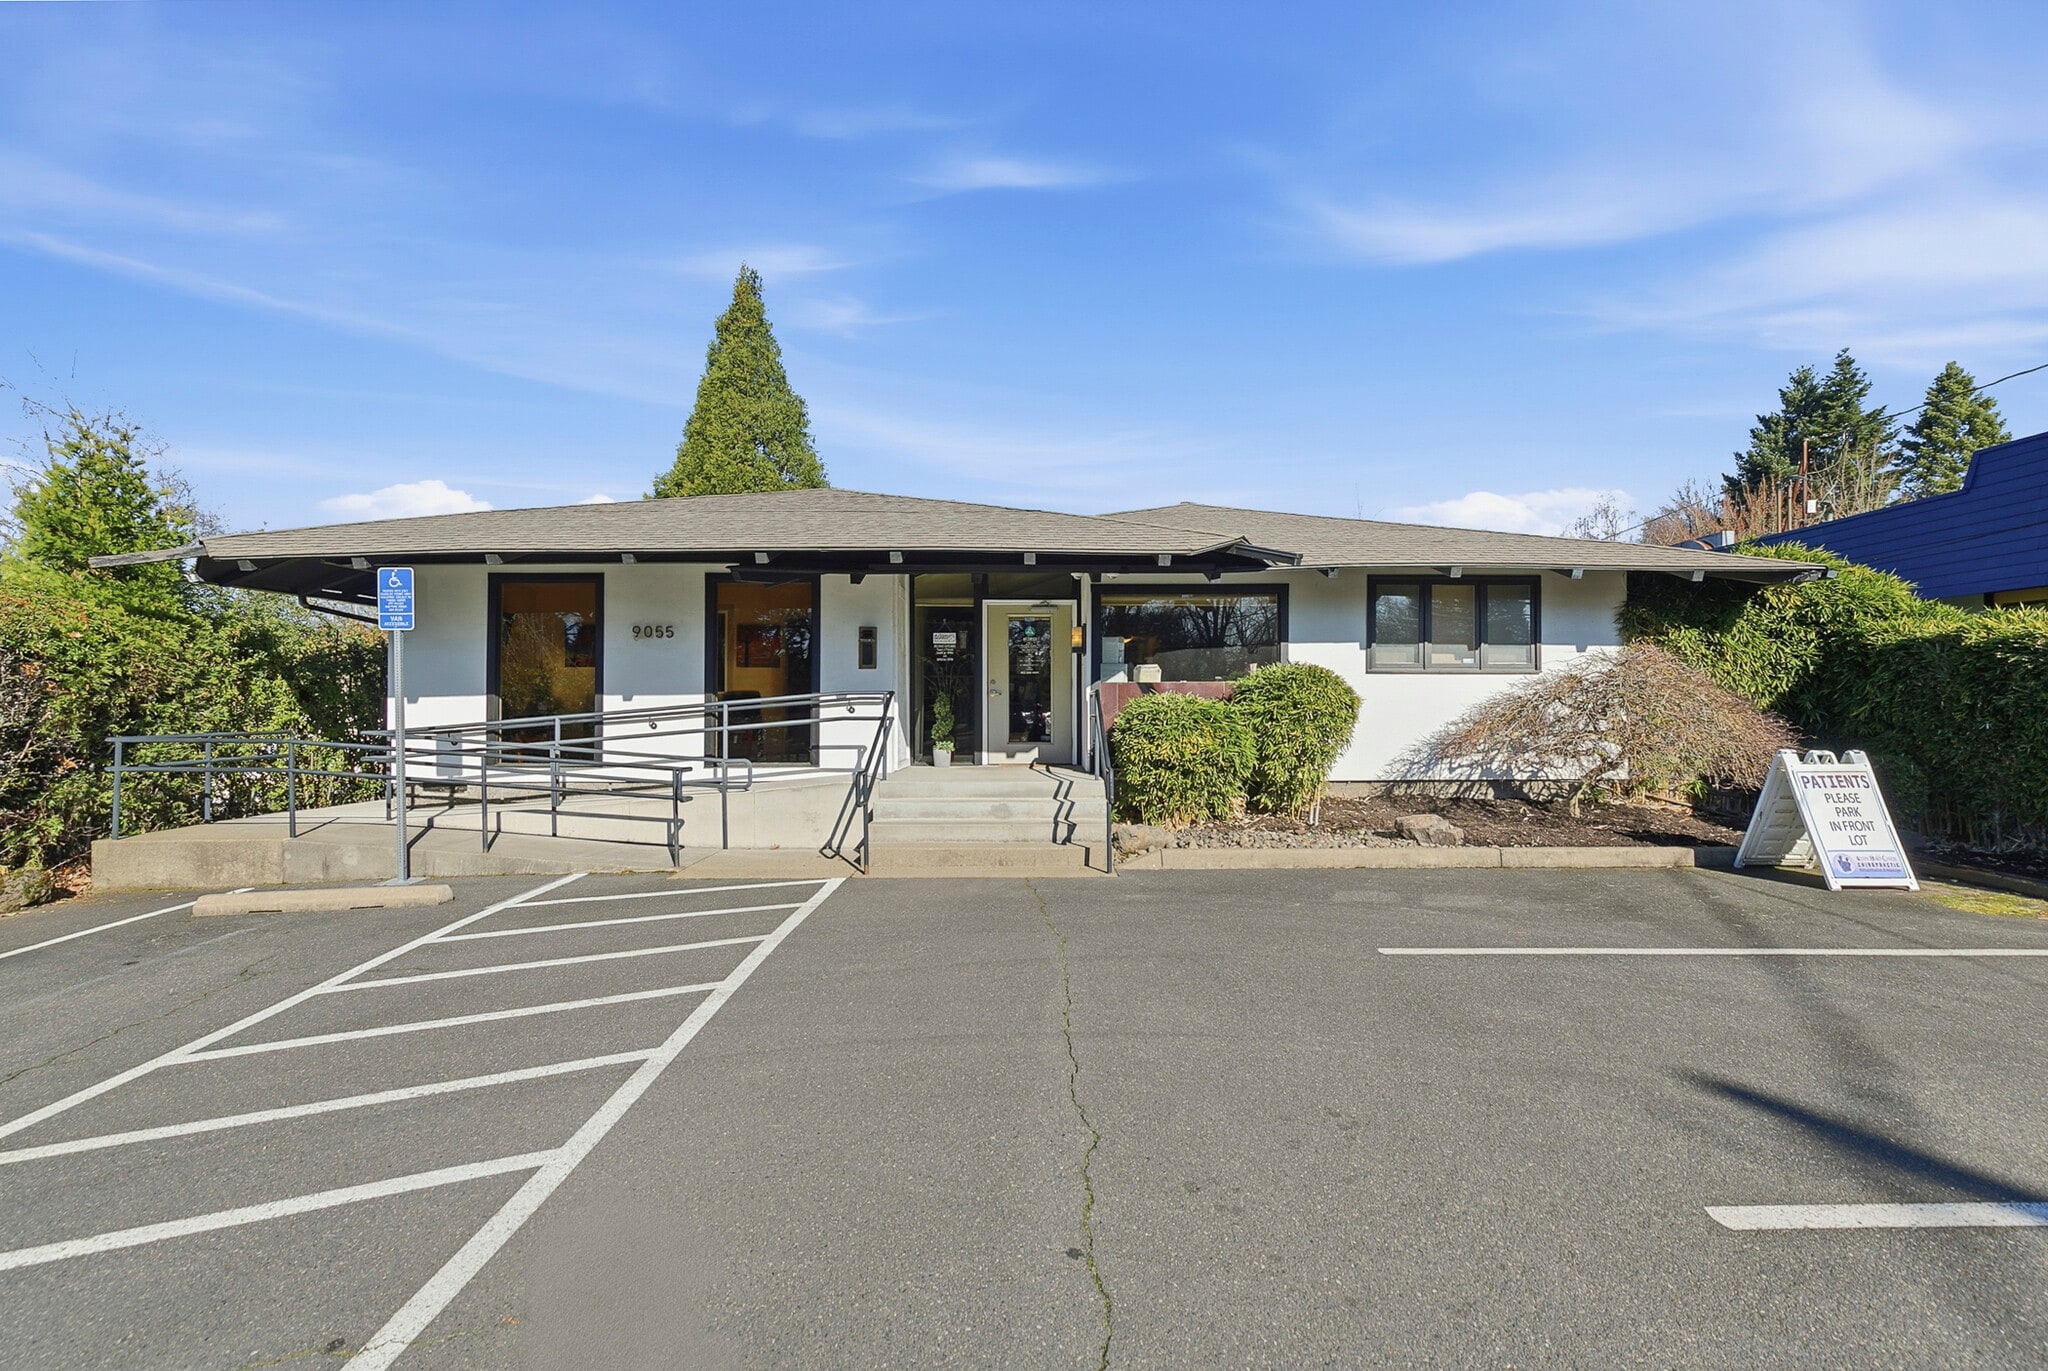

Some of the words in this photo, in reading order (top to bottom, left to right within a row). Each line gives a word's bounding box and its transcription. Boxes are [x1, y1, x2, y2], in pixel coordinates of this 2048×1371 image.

[632, 625, 675, 639] 9055
[1800, 775, 1870, 789] PATIENTS
[1824, 793, 1861, 804] PLEASE
[1835, 806, 1862, 817] PARK
[1829, 820, 1843, 832] IN
[1842, 820, 1876, 832] FRONT
[1848, 834, 1868, 846] LOT
